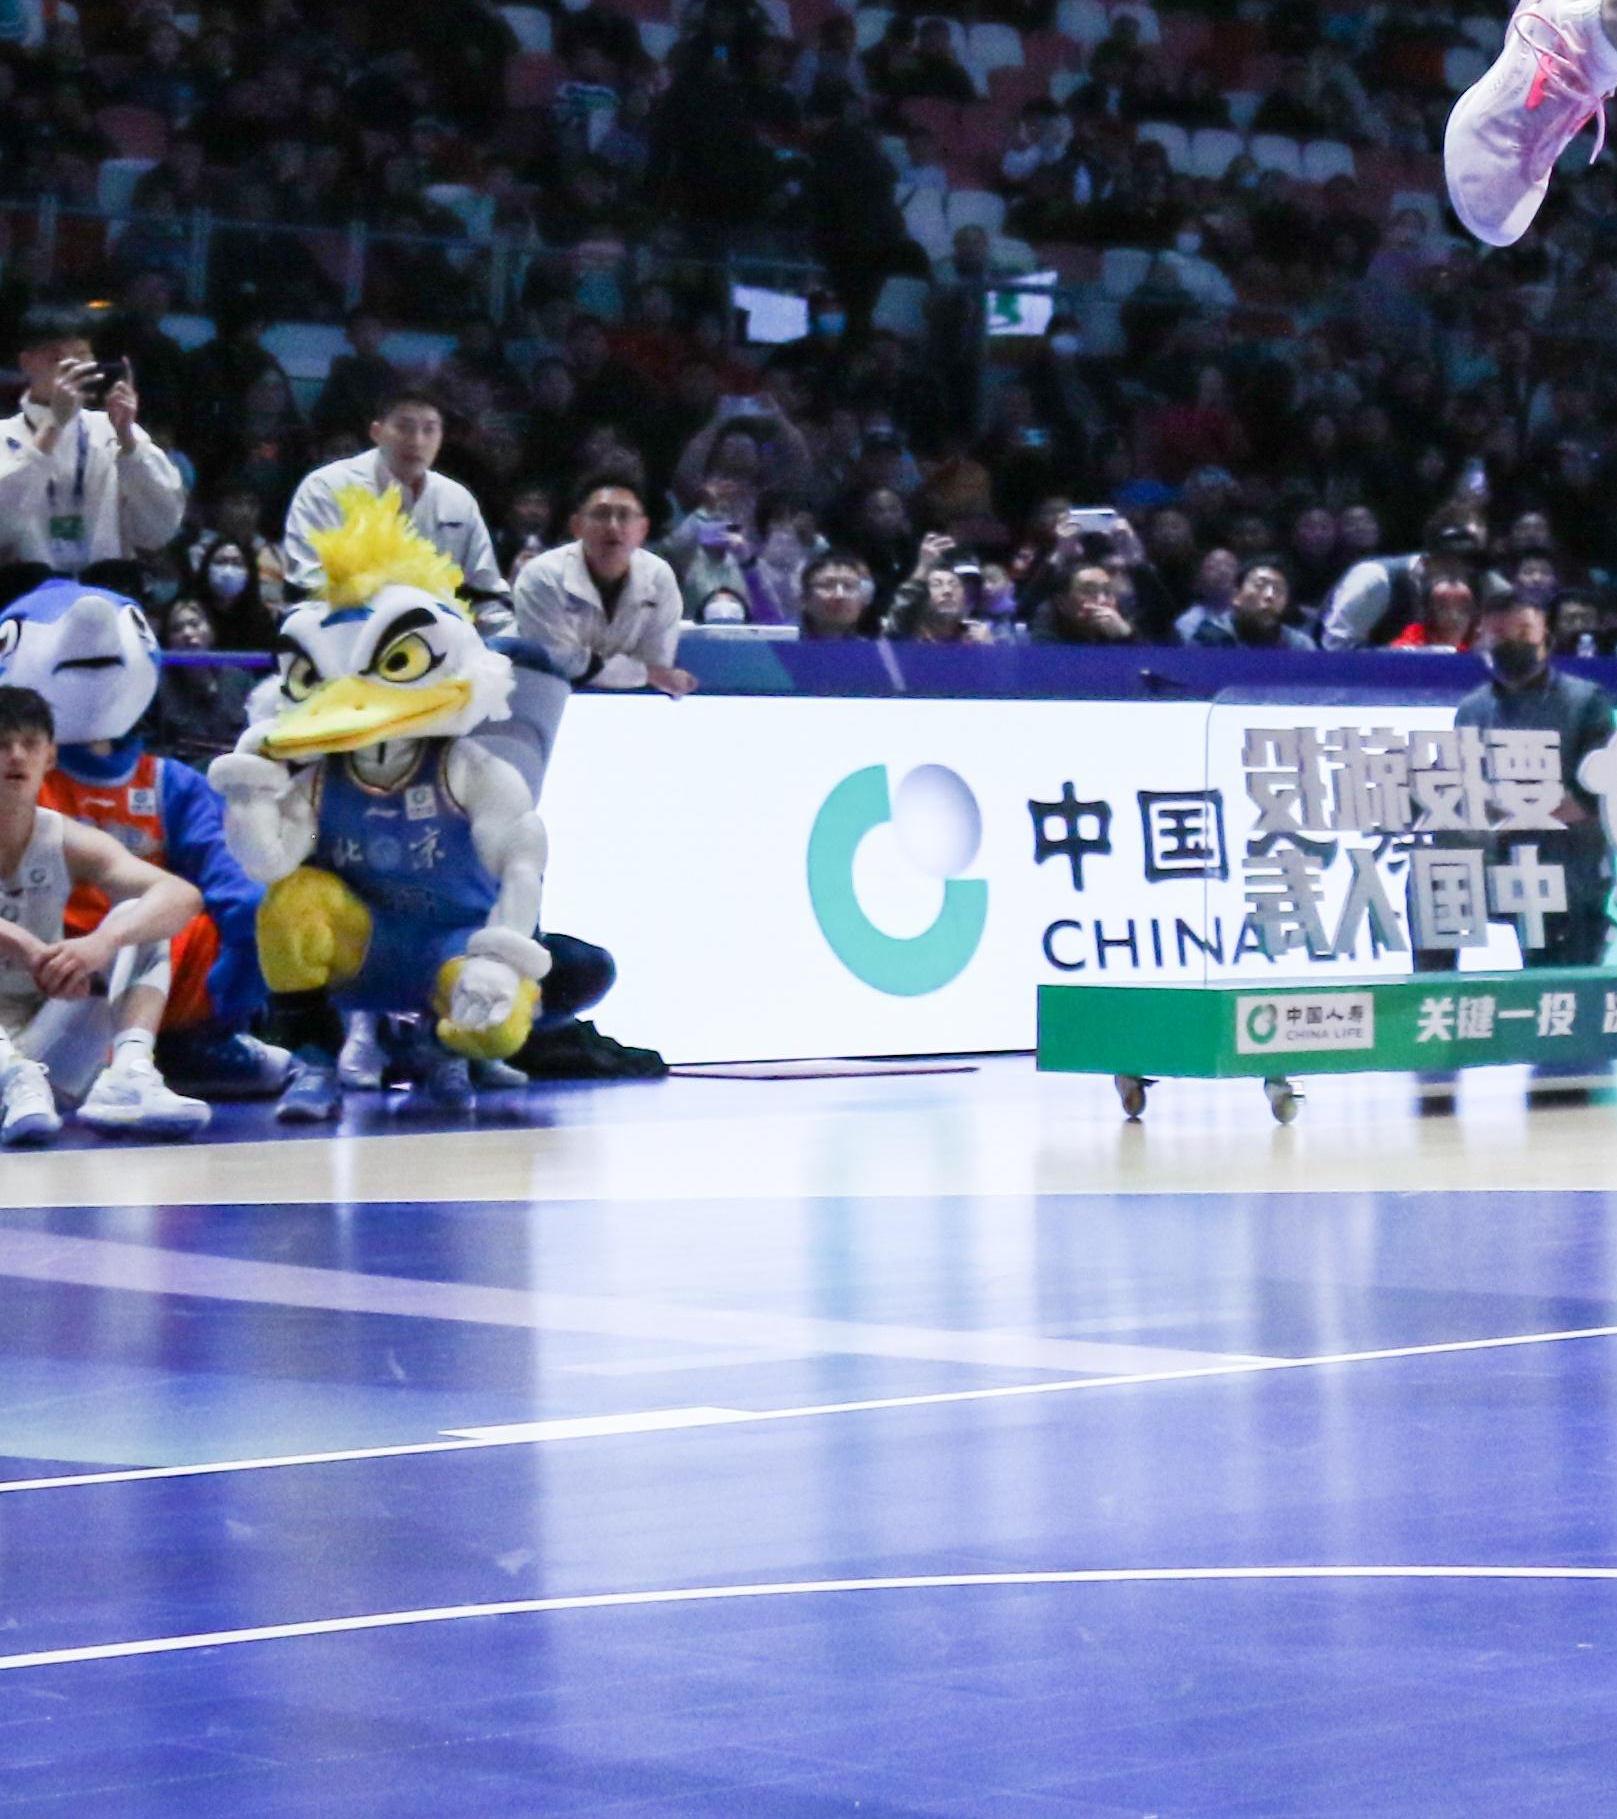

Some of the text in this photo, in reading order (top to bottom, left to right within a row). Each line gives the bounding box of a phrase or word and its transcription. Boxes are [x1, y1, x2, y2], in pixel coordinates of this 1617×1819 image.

[1286, 1004, 1365, 1027] 中国人寿
[1416, 991, 1578, 1044] 关键一投
[1285, 1026, 1364, 1043] CHINA LIFE
